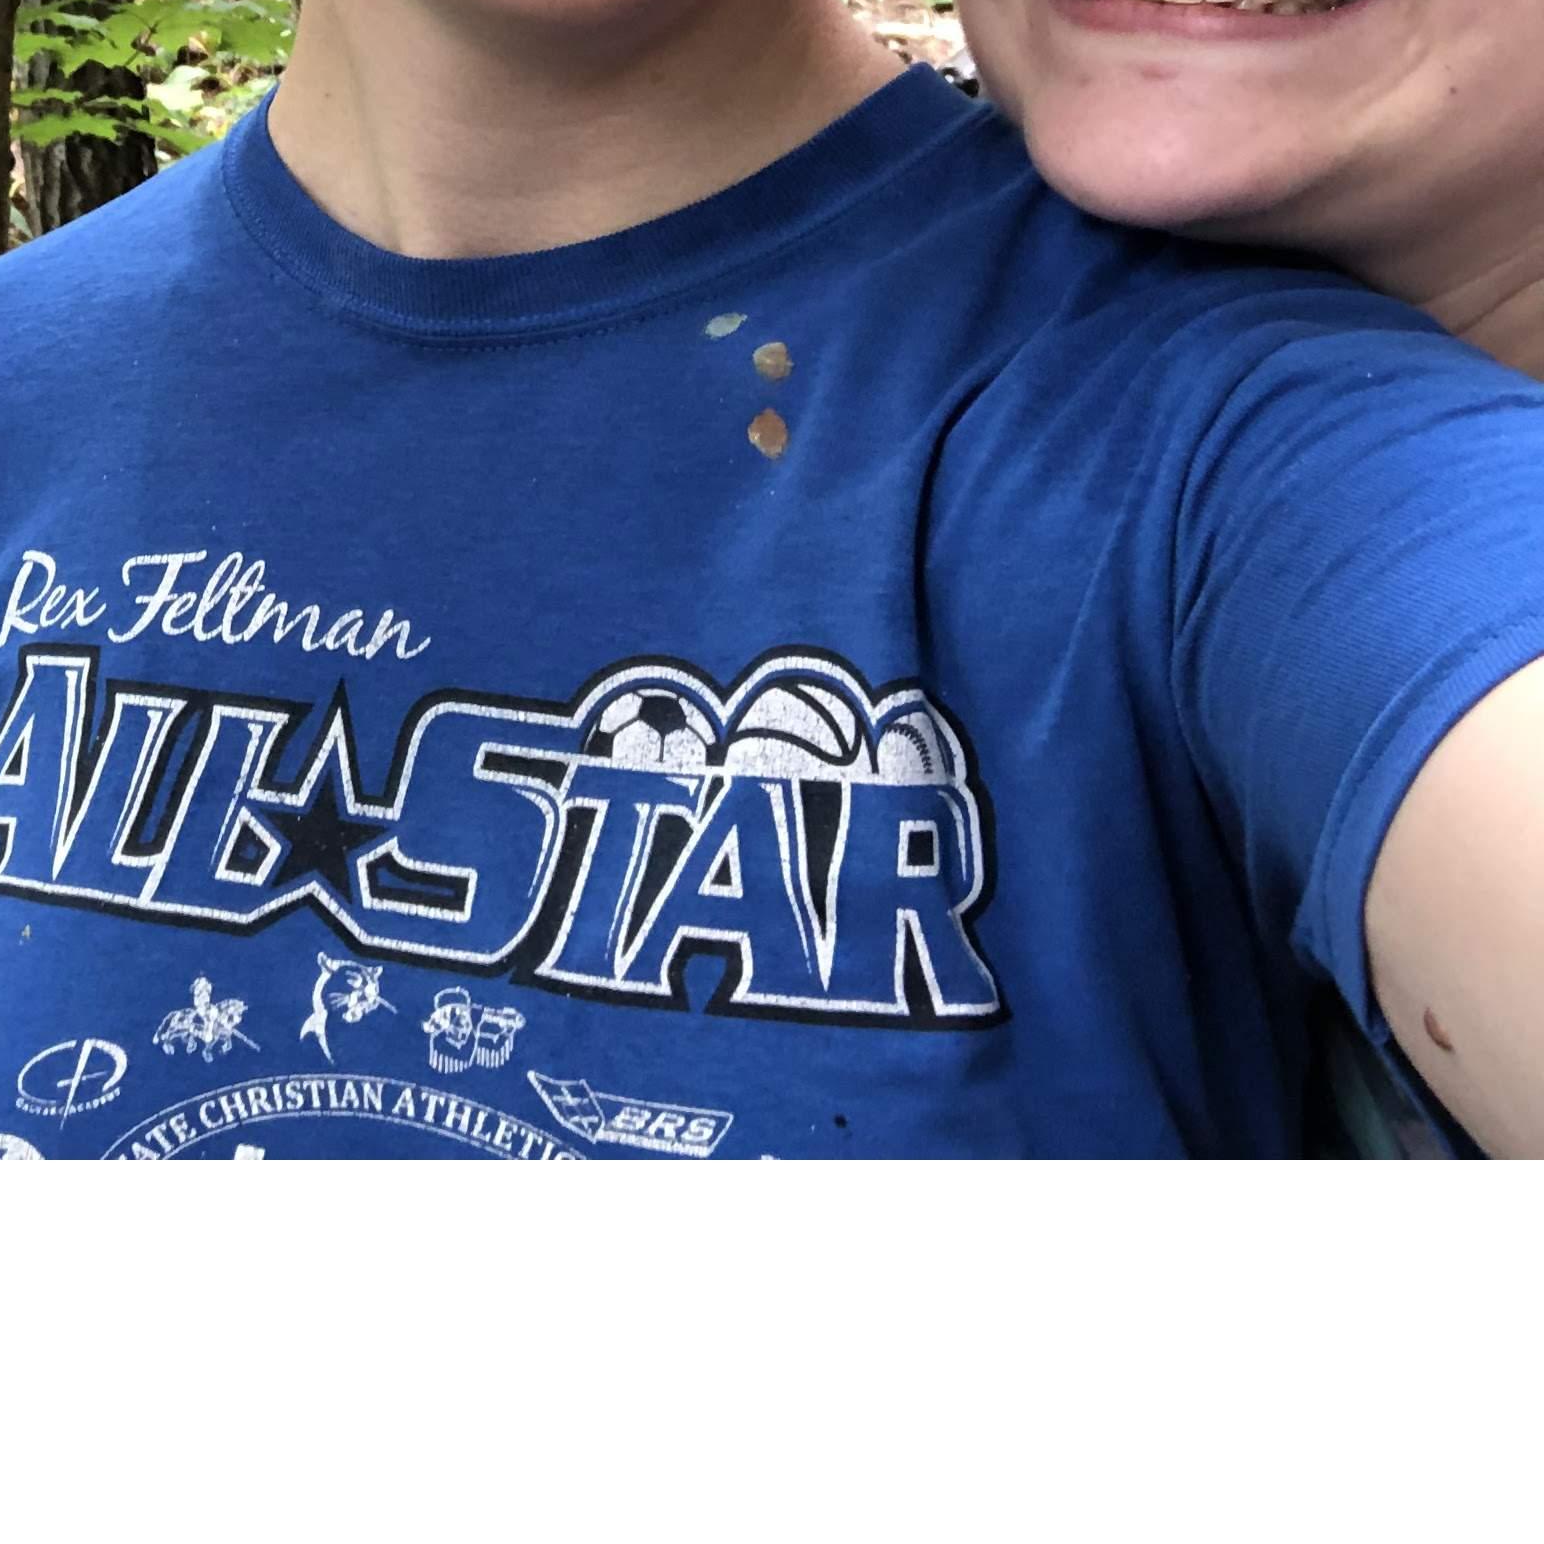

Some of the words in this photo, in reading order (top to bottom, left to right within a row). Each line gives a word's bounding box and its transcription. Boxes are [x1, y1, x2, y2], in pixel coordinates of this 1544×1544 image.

[108, 549, 431, 660] Feltman
[349, 688, 1008, 1030] STAR
[116, 1111, 197, 1160] ATE
[199, 1078, 384, 1129] CHRISTIAN
[610, 1106, 718, 1143] BRS
